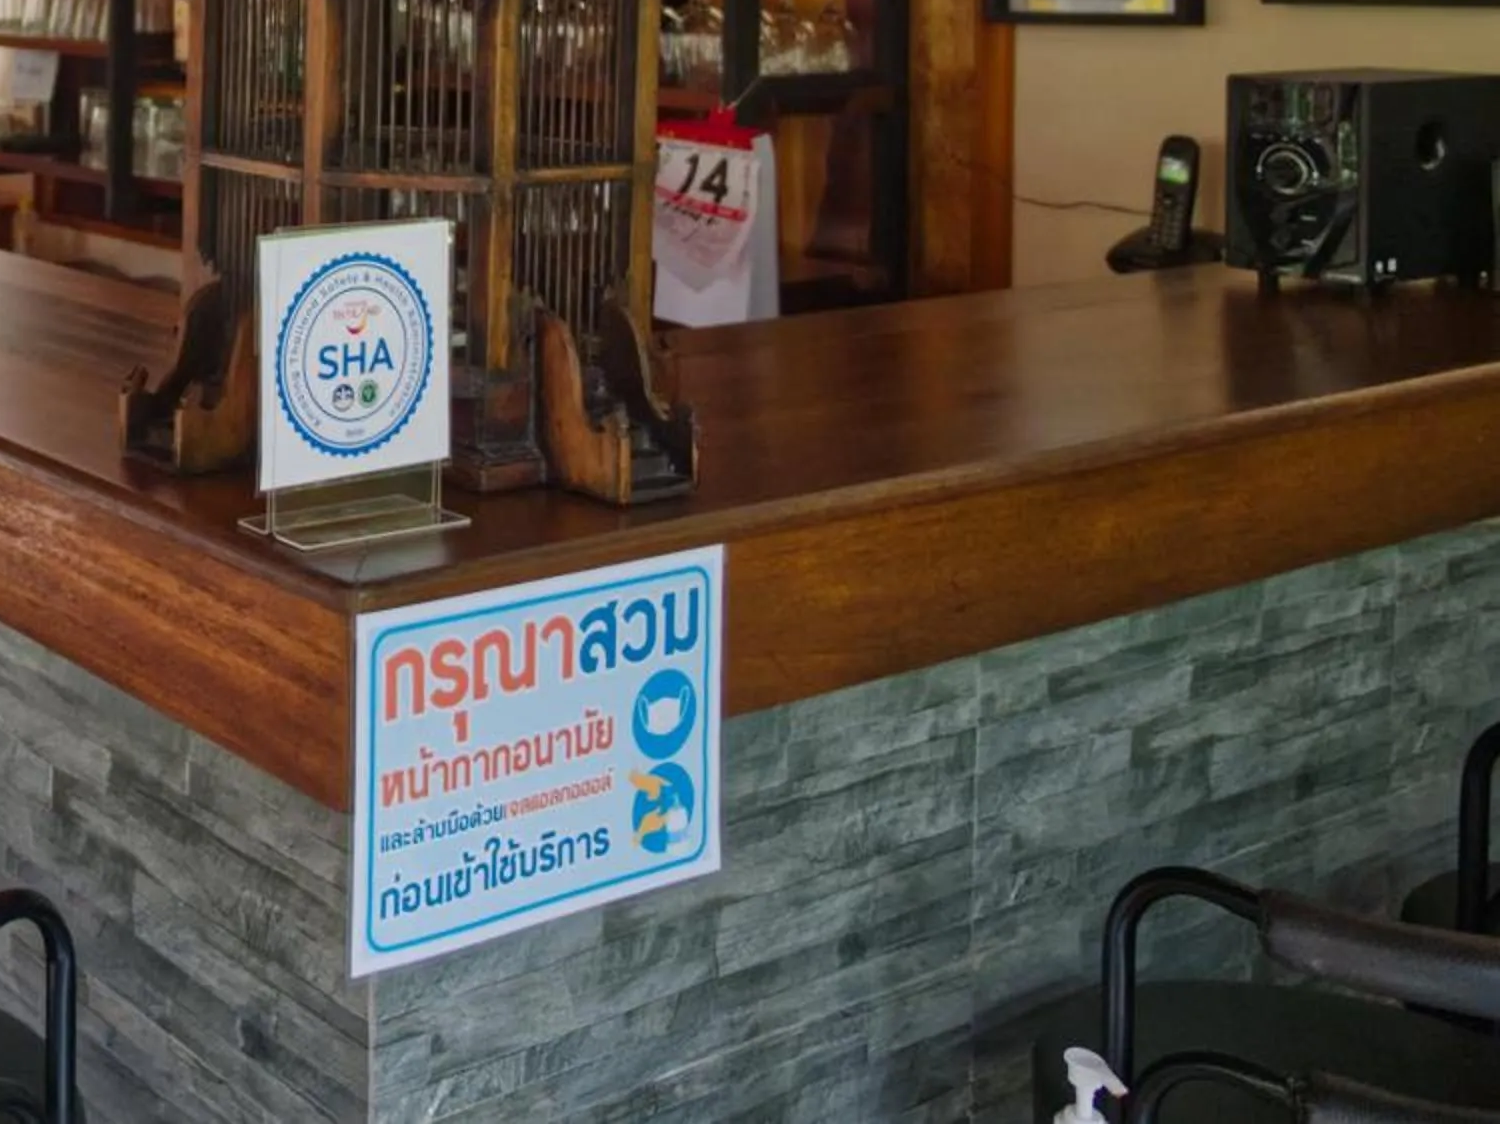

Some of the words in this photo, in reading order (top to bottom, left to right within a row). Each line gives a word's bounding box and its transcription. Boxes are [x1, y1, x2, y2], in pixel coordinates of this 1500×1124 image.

[674, 154, 728, 211] 14
[317, 338, 394, 380] SHA
[384, 588, 699, 741] กรุณาสวม
[381, 712, 614, 806] หน้ากากอนามัย
[380, 827, 610, 919] ก่อนเข้าใช้บริการ
